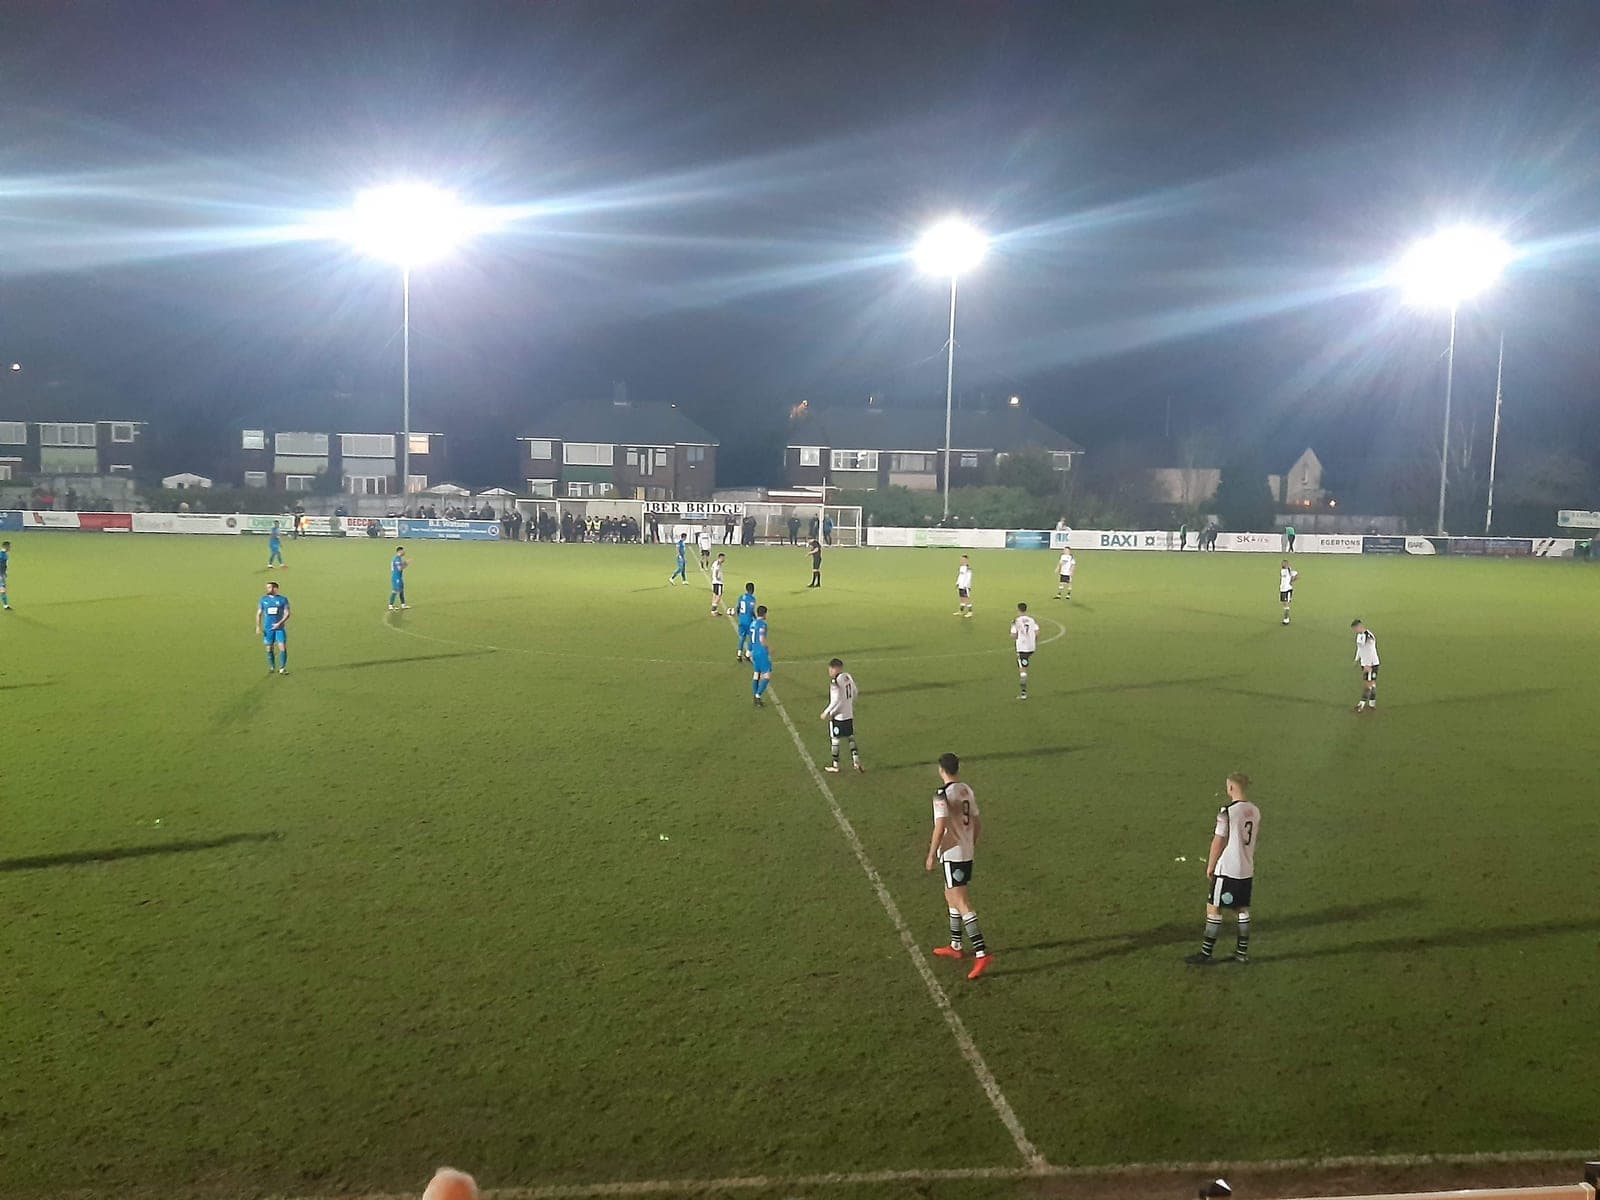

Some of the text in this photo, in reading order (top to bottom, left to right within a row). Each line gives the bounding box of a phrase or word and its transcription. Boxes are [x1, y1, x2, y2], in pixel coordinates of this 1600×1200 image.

[686, 503, 742, 514] BRIDGE
[1100, 534, 1138, 547] BAXI
[1024, 624, 1030, 633] 7
[845, 683, 852, 700] 11
[962, 800, 969, 825] 9
[1244, 821, 1253, 846] 3
